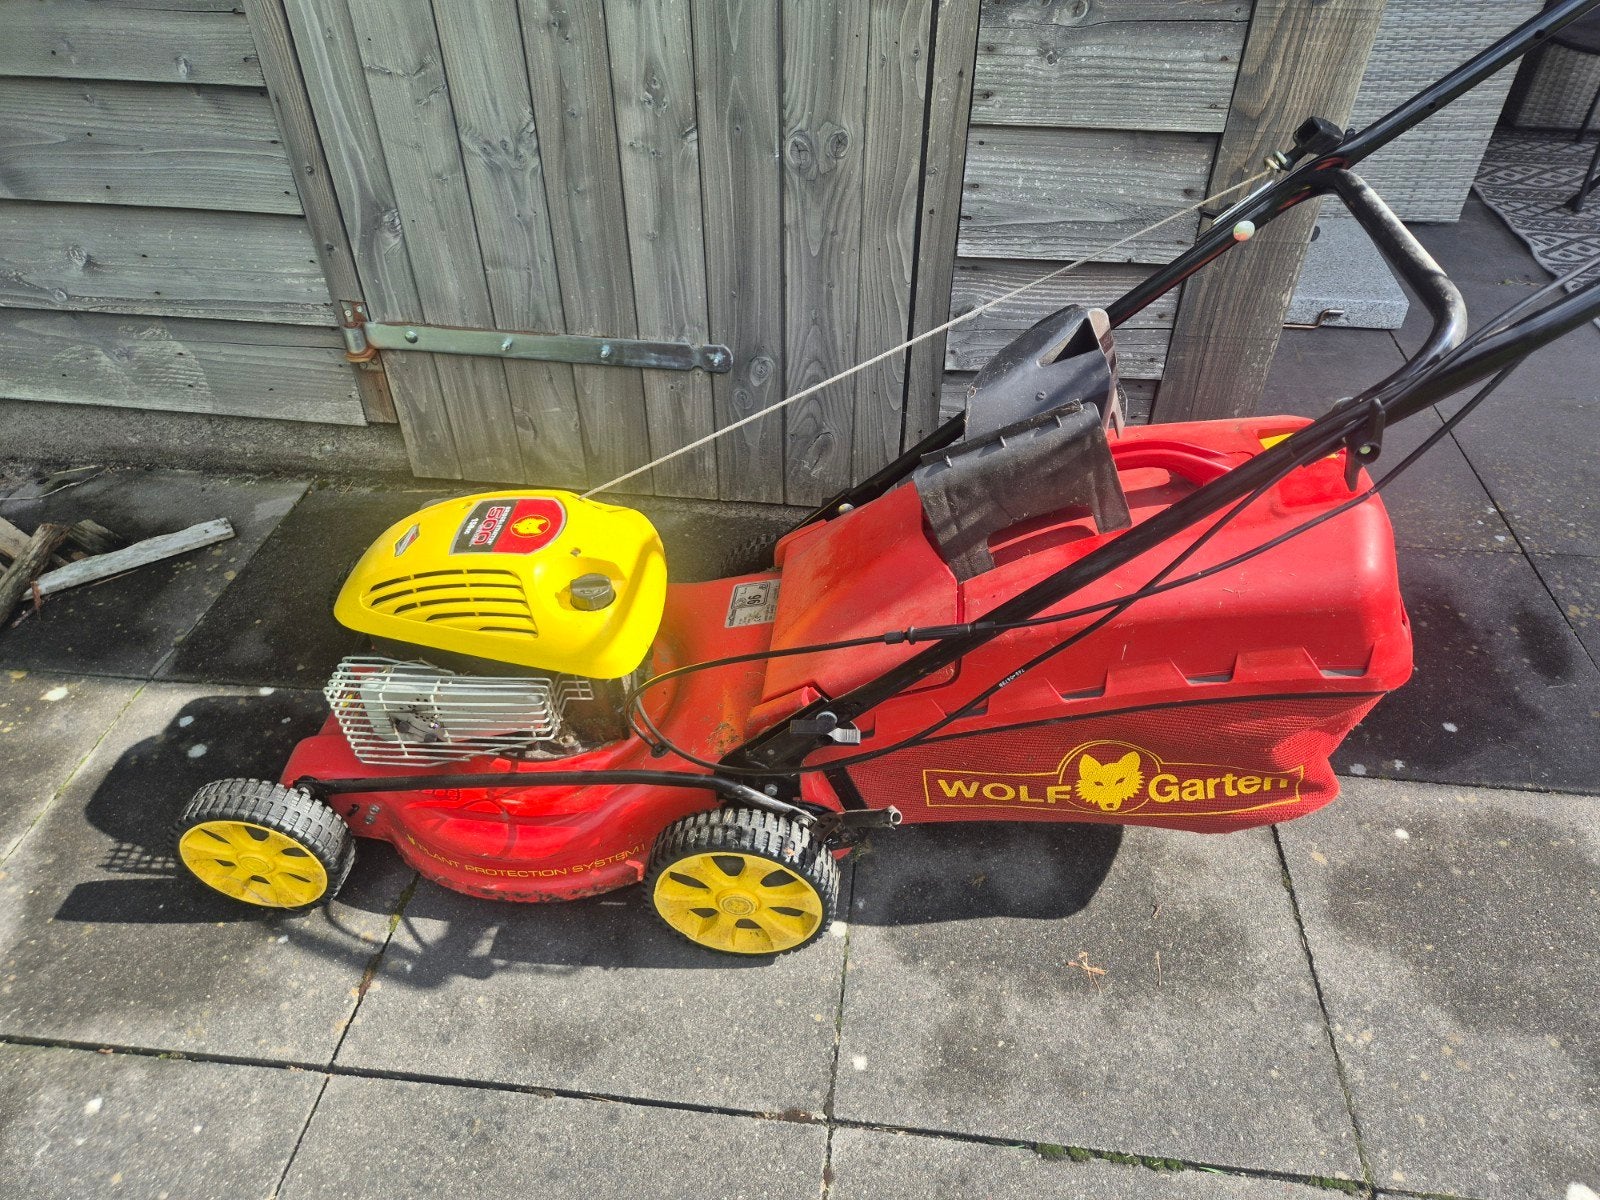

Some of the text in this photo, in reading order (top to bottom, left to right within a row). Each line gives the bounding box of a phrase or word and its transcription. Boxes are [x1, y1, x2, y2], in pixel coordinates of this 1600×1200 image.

[473, 506, 506, 546] 500
[937, 773, 1288, 804] WOLF Garten
[464, 864, 567, 878] PROTECTION
[572, 846, 640, 873] SYSTEM
